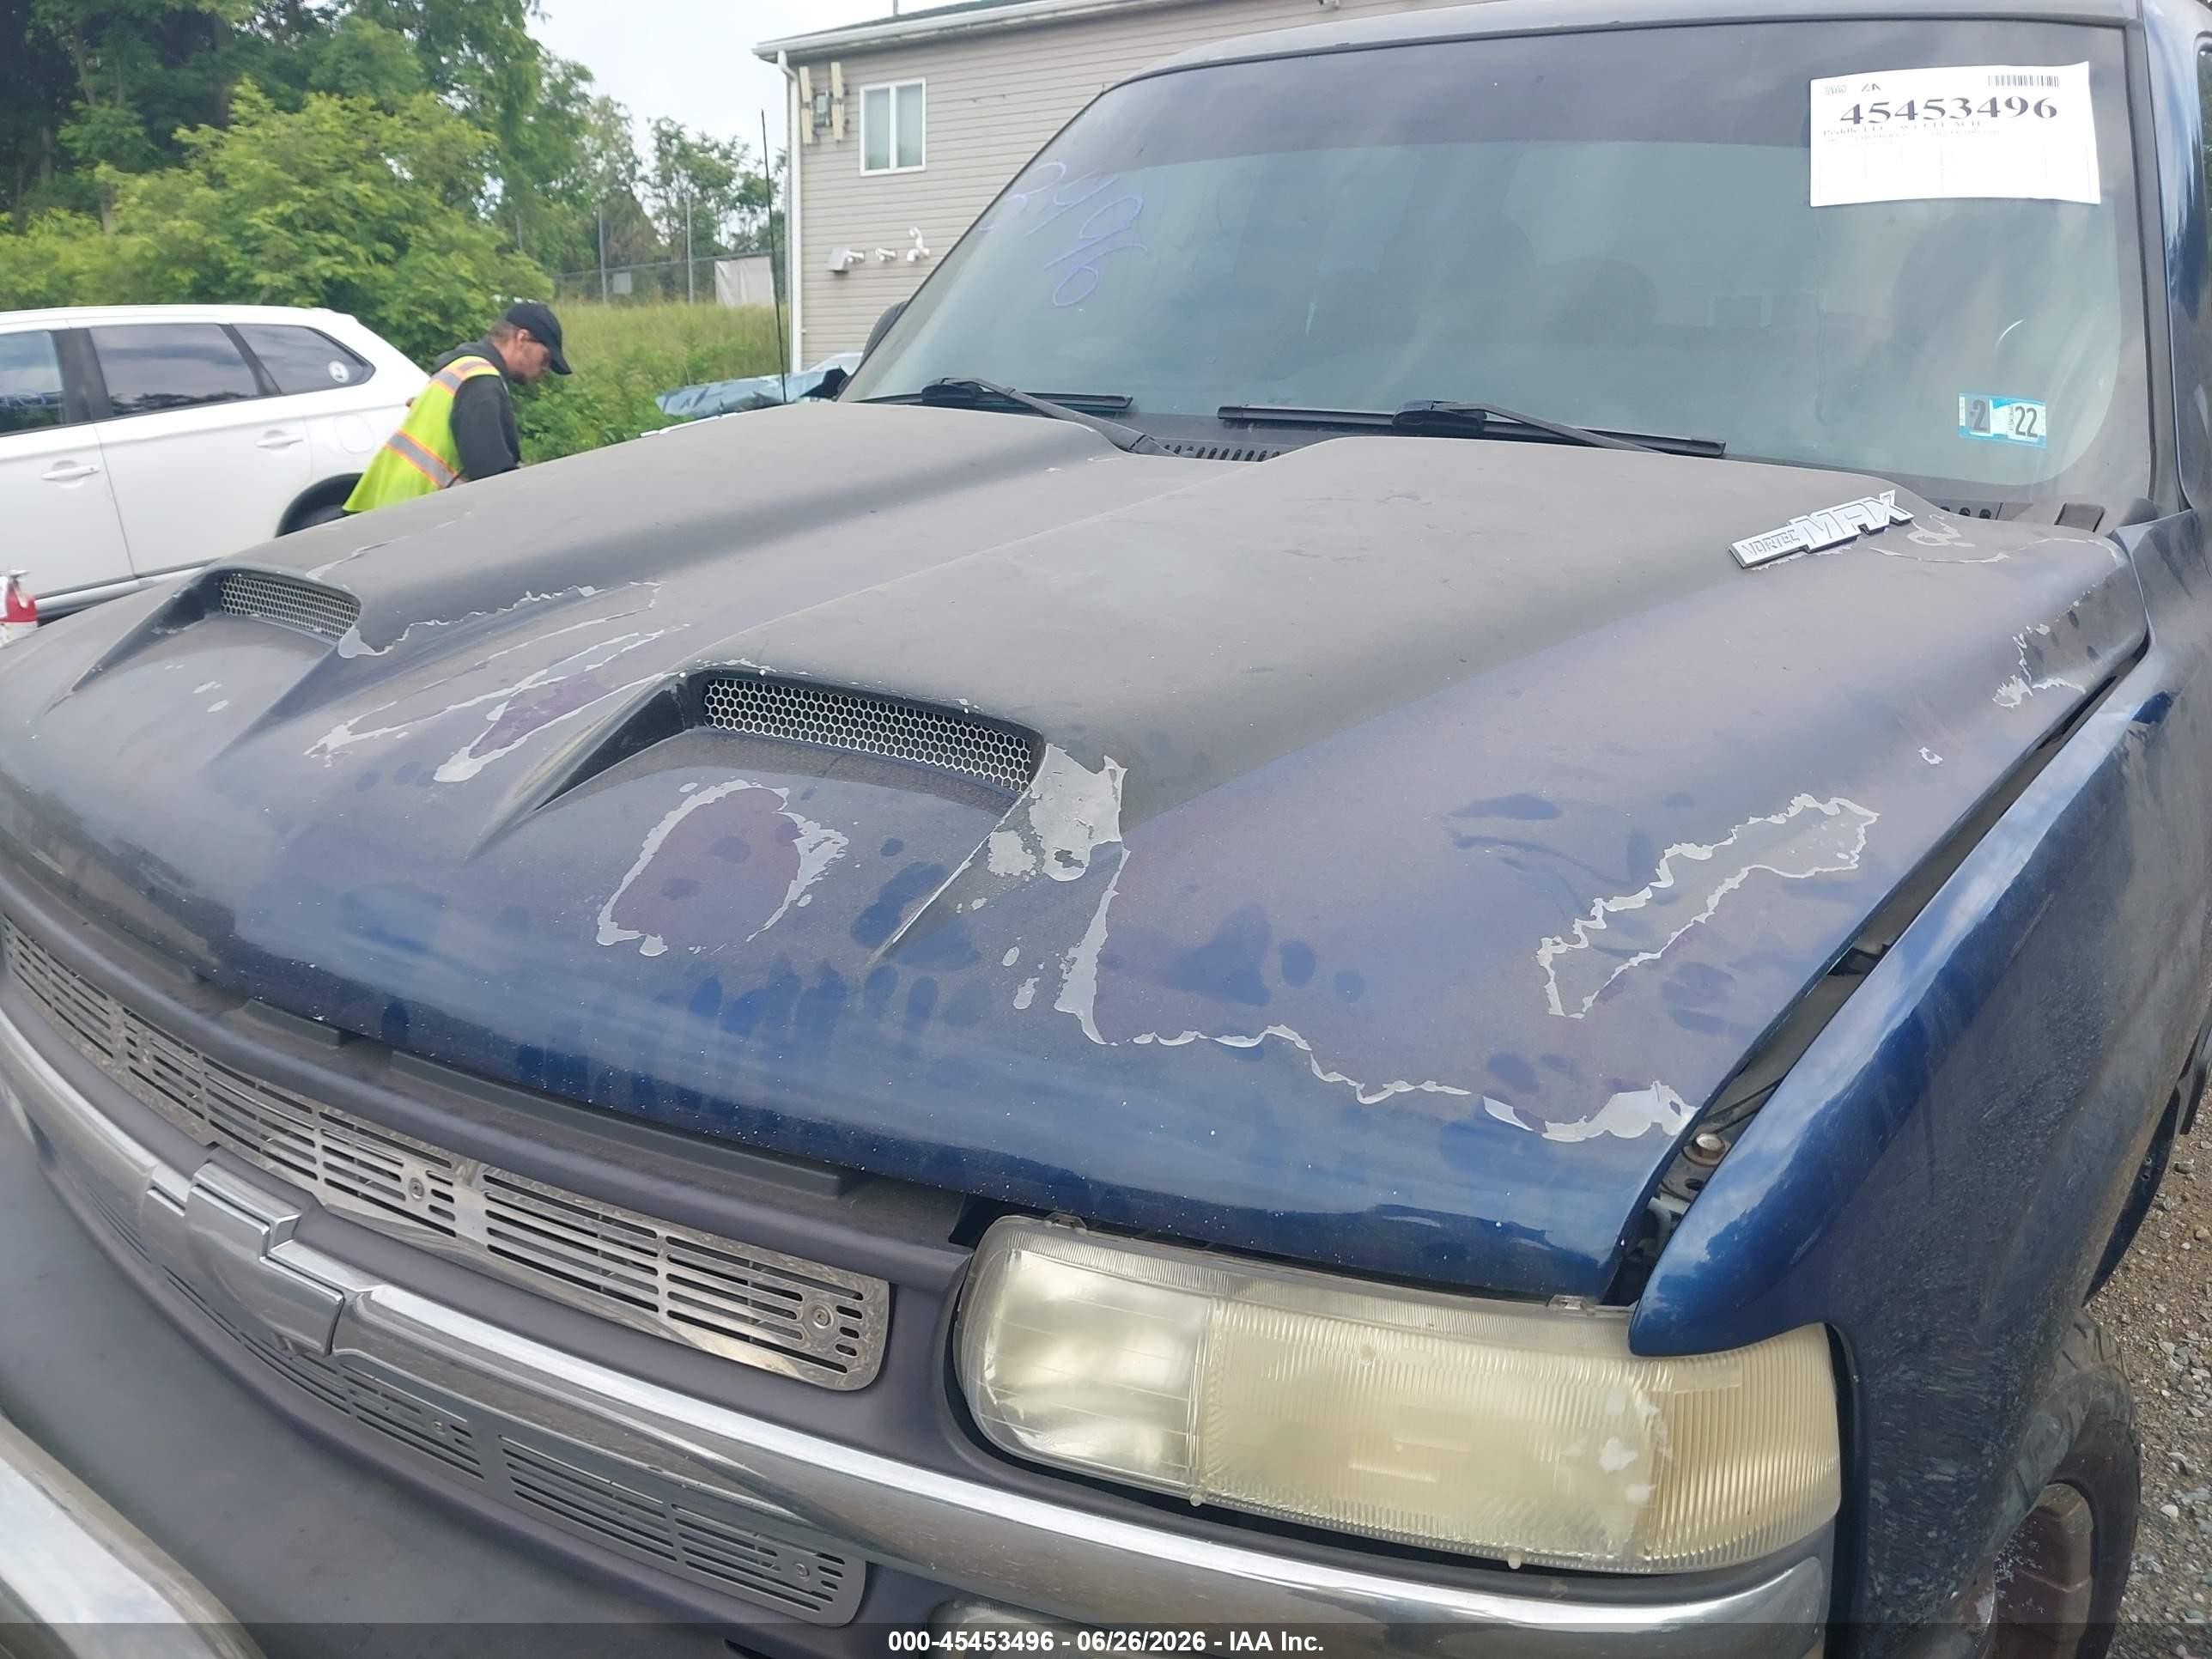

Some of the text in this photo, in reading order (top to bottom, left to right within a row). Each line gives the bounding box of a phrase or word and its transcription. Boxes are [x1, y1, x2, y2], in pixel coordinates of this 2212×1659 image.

[1840, 95, 2058, 125] 45453496
[2014, 405, 2038, 438] 22
[1741, 490, 1913, 556] VORTEC MAX
